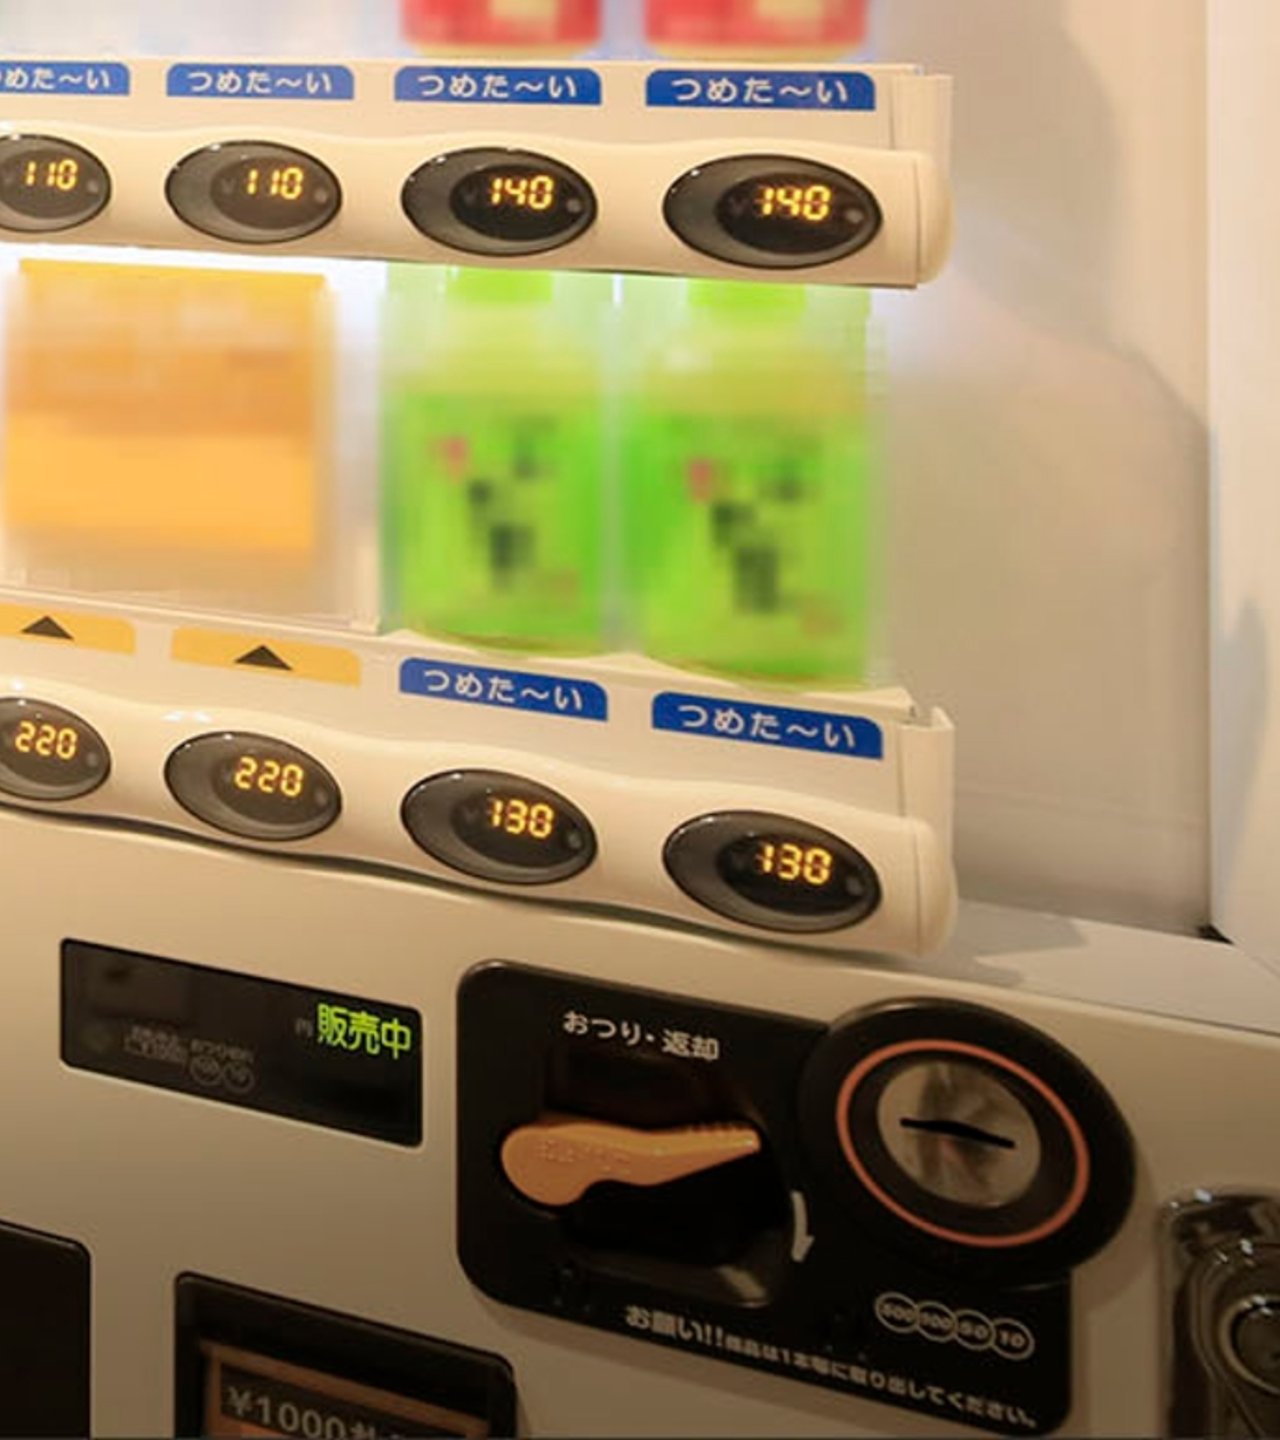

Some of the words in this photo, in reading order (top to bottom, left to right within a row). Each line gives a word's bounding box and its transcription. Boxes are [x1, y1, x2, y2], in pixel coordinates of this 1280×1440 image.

[22, 158, 78, 190] 110
[245, 167, 304, 201] 110
[489, 173, 553, 210] 140
[753, 185, 831, 222] 140
[14, 721, 78, 760] 220
[235, 756, 304, 798] 220
[485, 797, 554, 839] 130
[753, 842, 833, 886] 130
[316, 1002, 412, 1059] 販売中
[563, 1010, 720, 1061] おつり・返却
